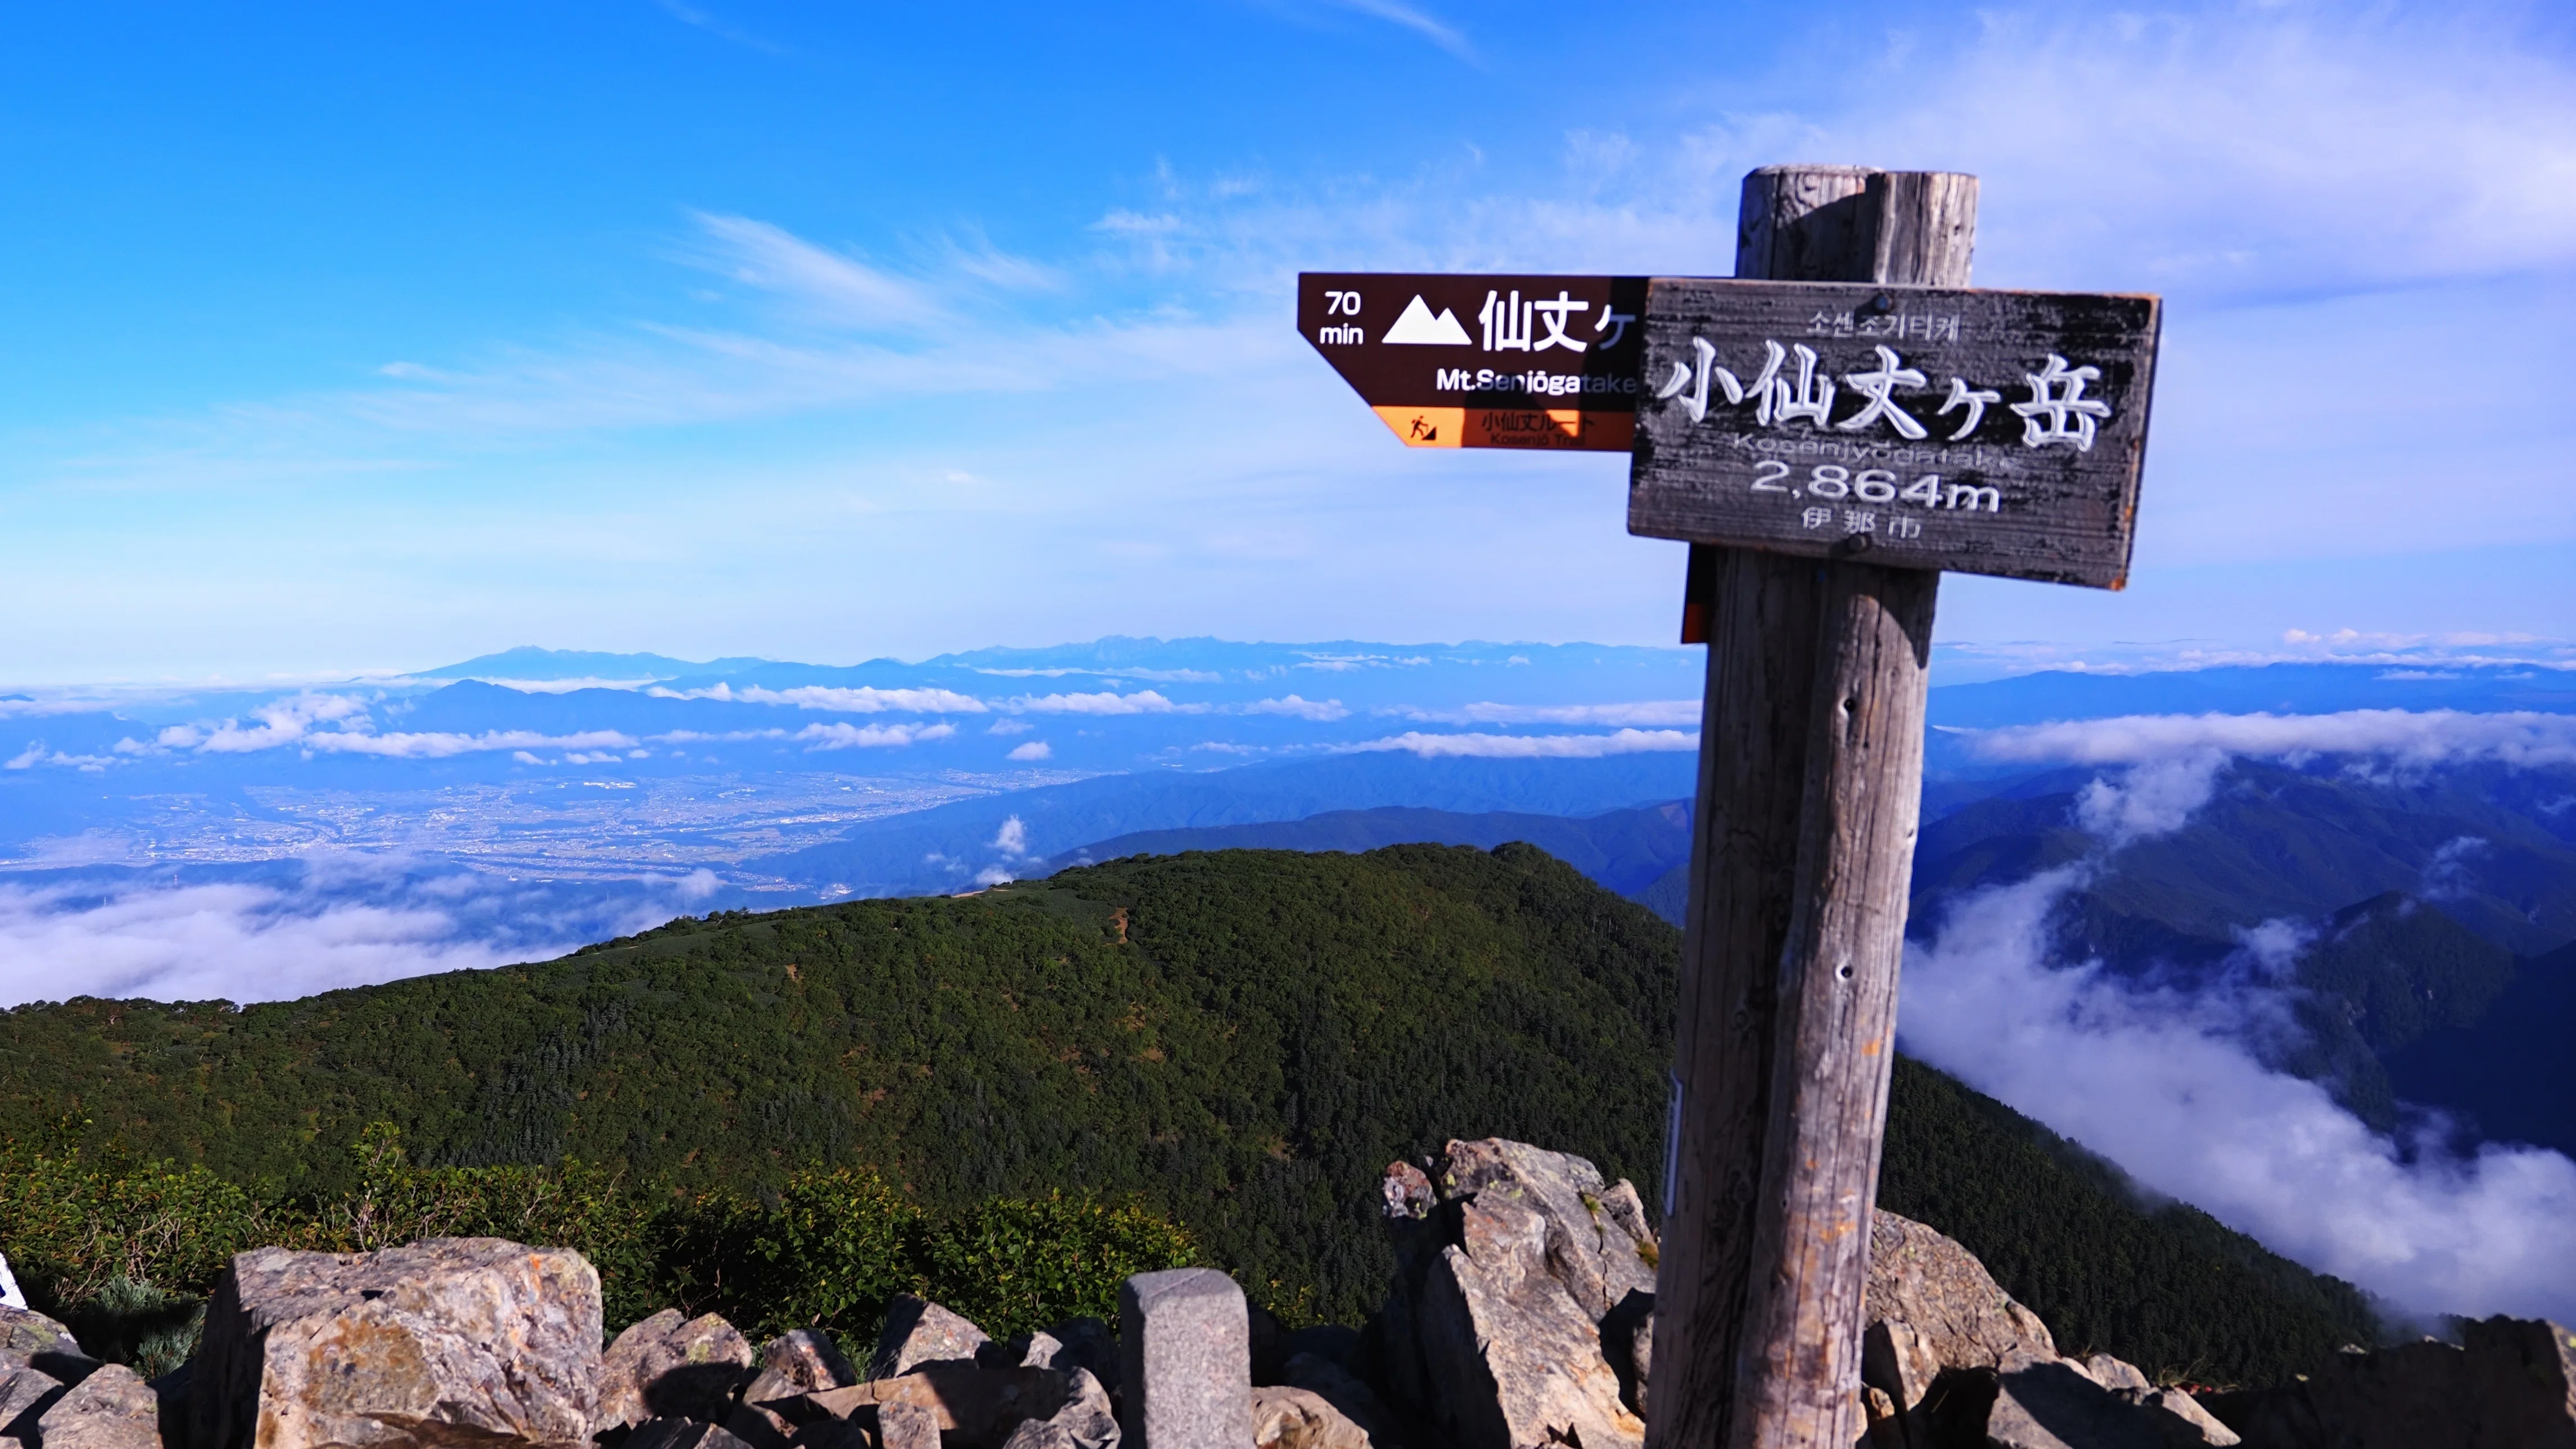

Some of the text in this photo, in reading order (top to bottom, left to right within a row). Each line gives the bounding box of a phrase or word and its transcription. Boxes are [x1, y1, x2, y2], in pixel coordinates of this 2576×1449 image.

[1324, 290, 1362, 316] 70
[1319, 322, 1364, 345] min
[1481, 410, 1595, 433] 小仙丈ルート
[1801, 506, 1921, 539] 伊那市
